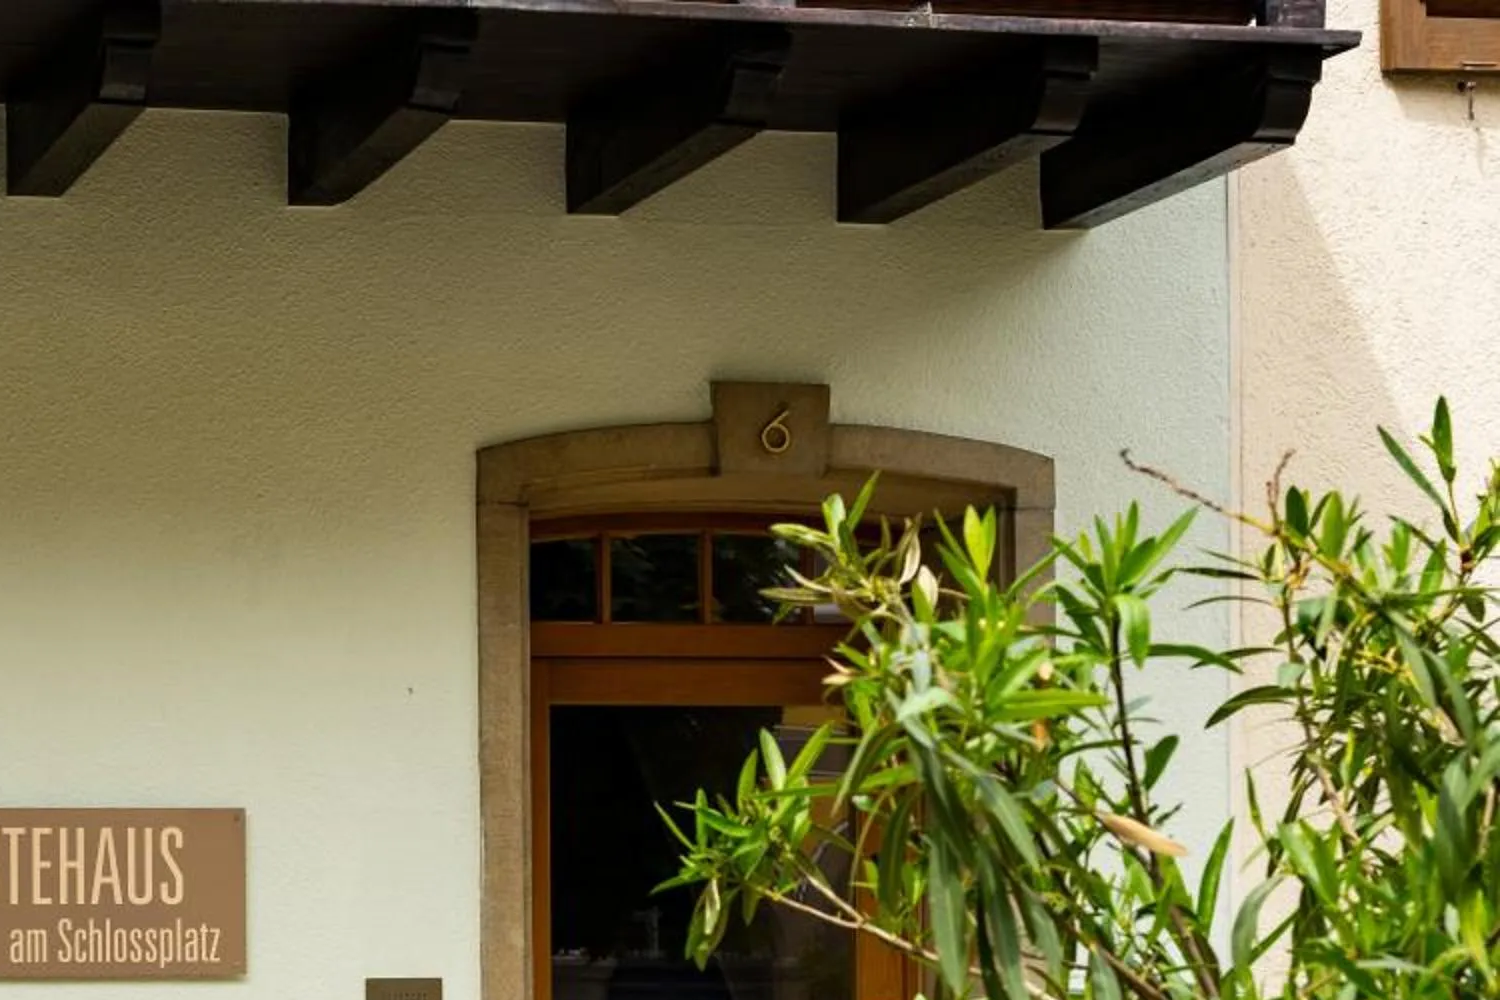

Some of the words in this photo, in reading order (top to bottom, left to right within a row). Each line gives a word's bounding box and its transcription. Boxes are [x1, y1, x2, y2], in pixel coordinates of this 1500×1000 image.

[761, 410, 791, 453] 6
[9, 927, 48, 963] am
[57, 917, 221, 969] Schlossplatz
